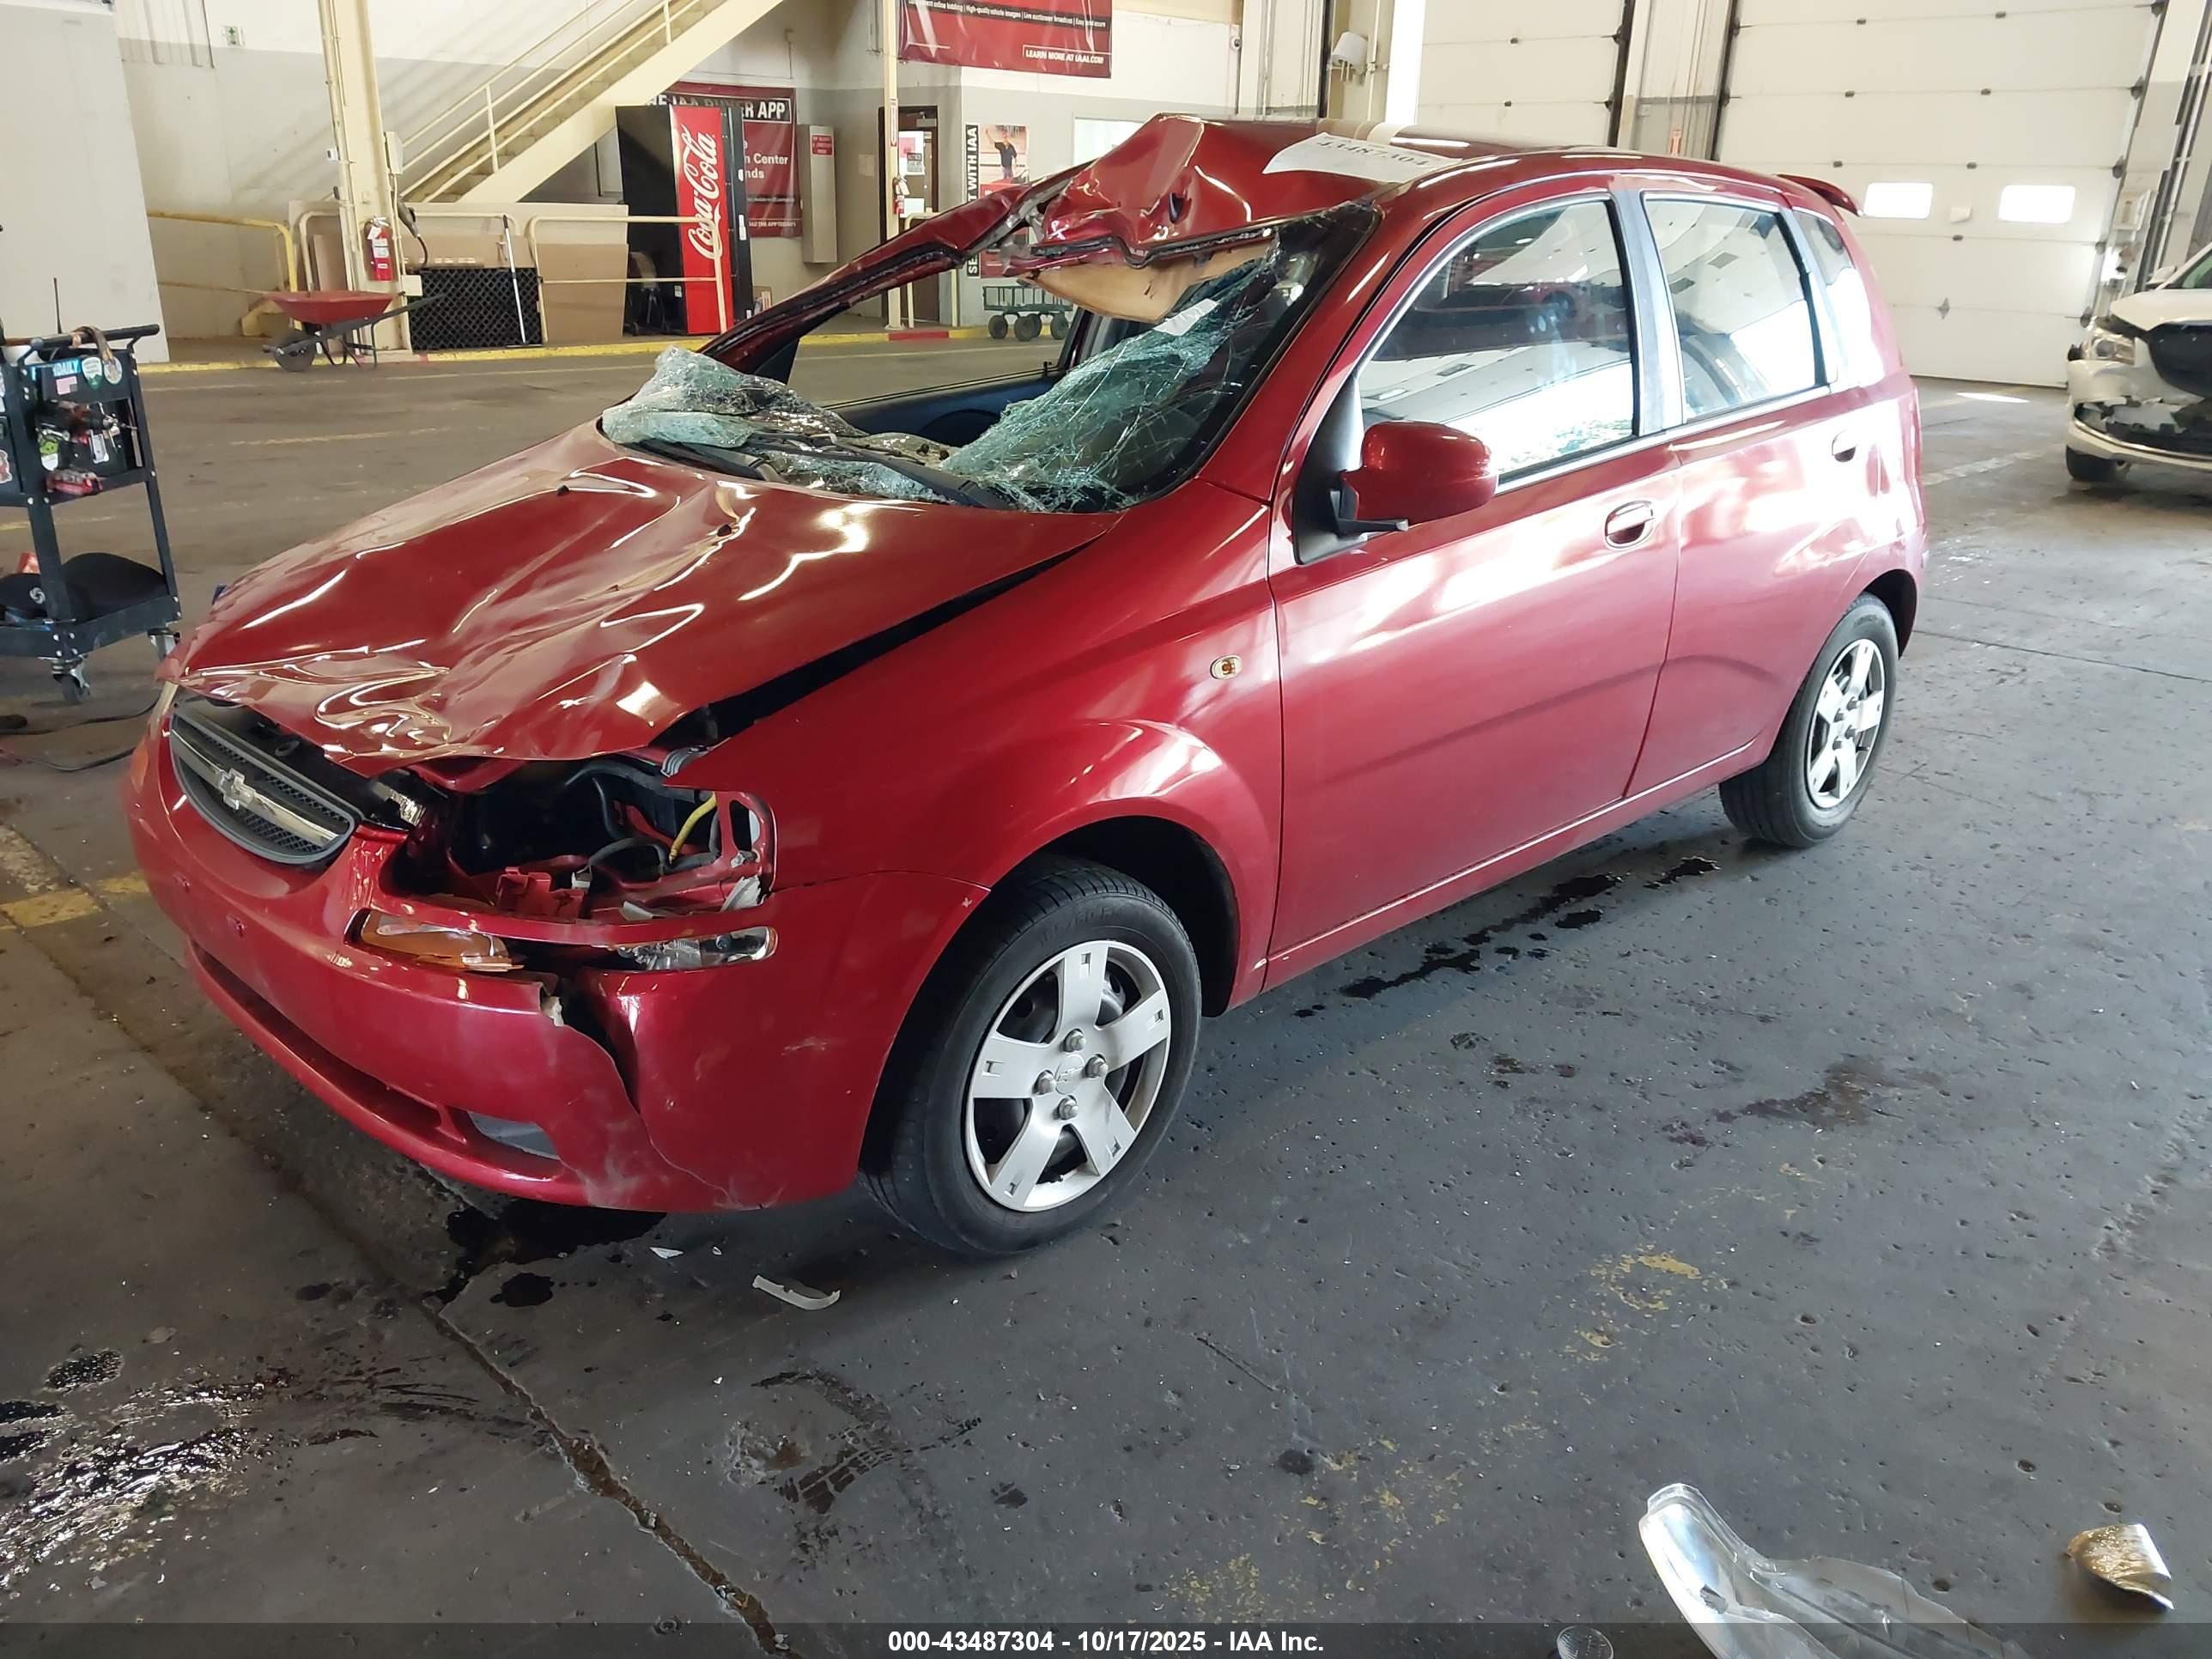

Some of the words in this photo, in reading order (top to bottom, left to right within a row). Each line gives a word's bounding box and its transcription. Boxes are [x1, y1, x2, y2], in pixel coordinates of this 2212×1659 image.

[1025, 50, 1047, 59] LEARN
[1048, 52, 1065, 61] MORE
[757, 100, 786, 120] APP
[967, 127, 978, 153] IAA
[753, 152, 789, 165] Center
[745, 168, 765, 179] nds
[967, 155, 979, 191] WITH
[681, 124, 723, 259] Coca-Cola
